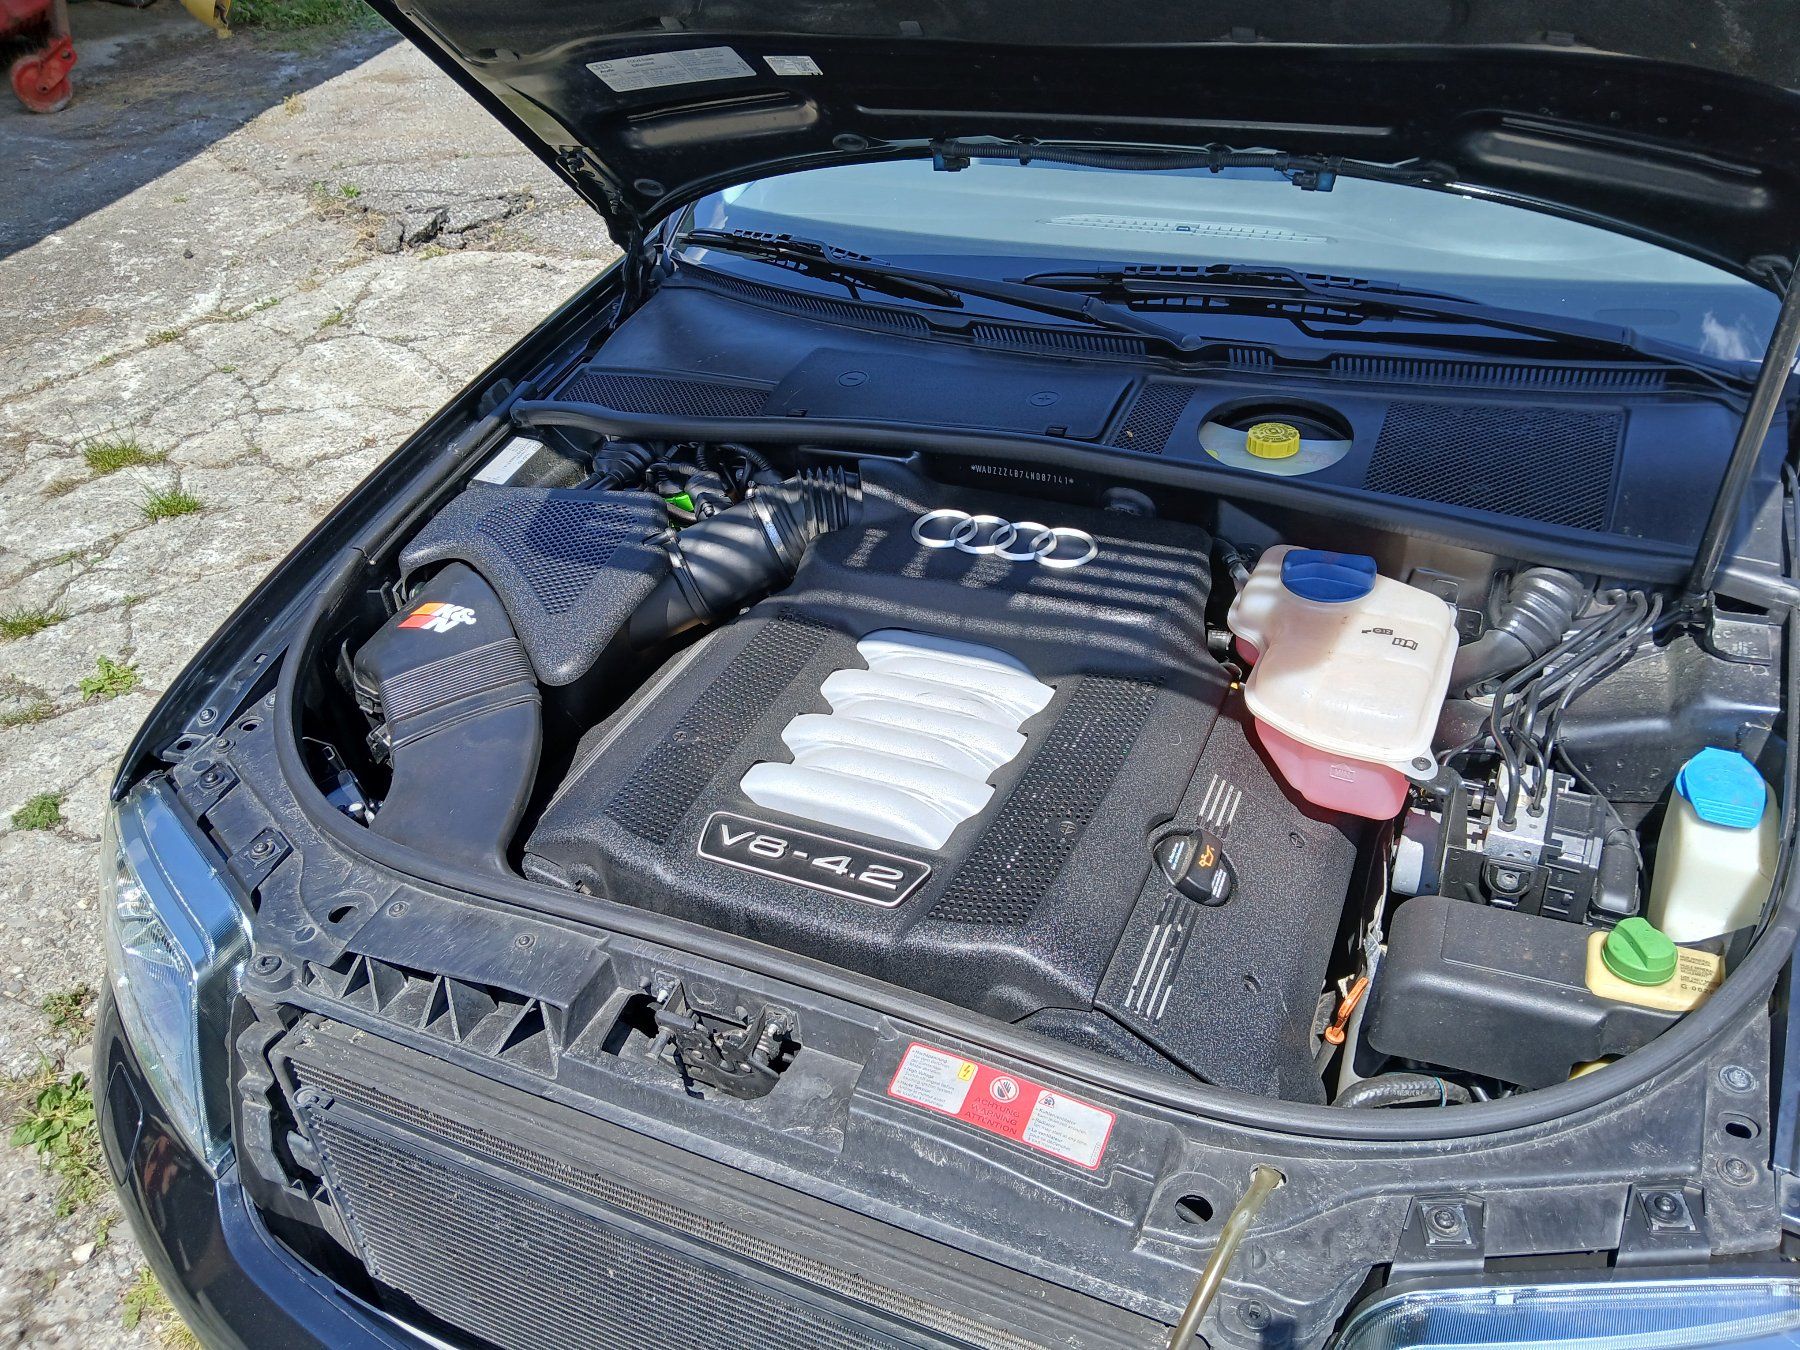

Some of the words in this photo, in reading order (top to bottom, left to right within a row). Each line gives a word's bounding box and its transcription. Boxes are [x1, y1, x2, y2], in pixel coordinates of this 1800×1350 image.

[720, 824, 904, 891] V8-4.2
[971, 1103, 1017, 1126] WARNING
[973, 1097, 1020, 1118] ACHTUNG
[964, 1111, 1017, 1135] ATTENTION
